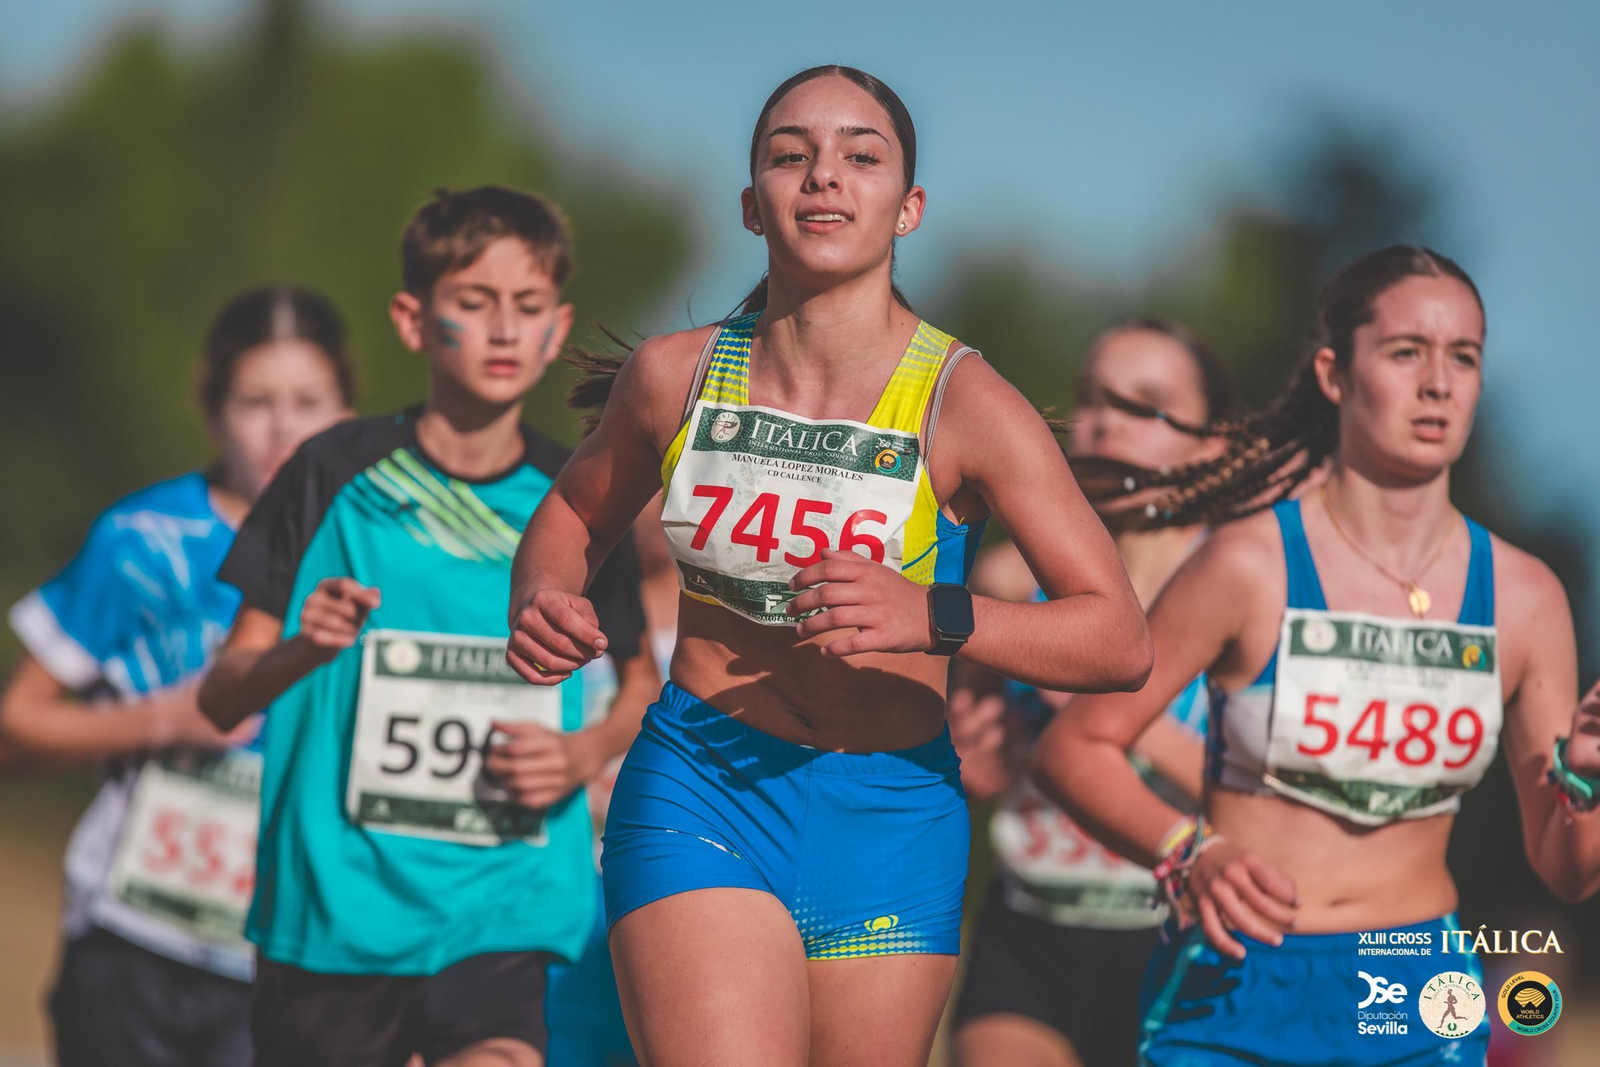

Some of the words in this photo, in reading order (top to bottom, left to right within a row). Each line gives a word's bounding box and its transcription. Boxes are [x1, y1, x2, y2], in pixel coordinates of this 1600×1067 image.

[749, 417, 858, 456] ITÁLICA
[731, 453, 779, 468] MANUELA
[781, 459, 813, 472] LOPEZ
[815, 466, 864, 481] MORALES
[767, 469, 778, 477] CD
[780, 471, 822, 484] CALLENCE
[690, 484, 888, 568] 7456
[380, 715, 501, 780] 59
[1297, 692, 1484, 770] 5489
